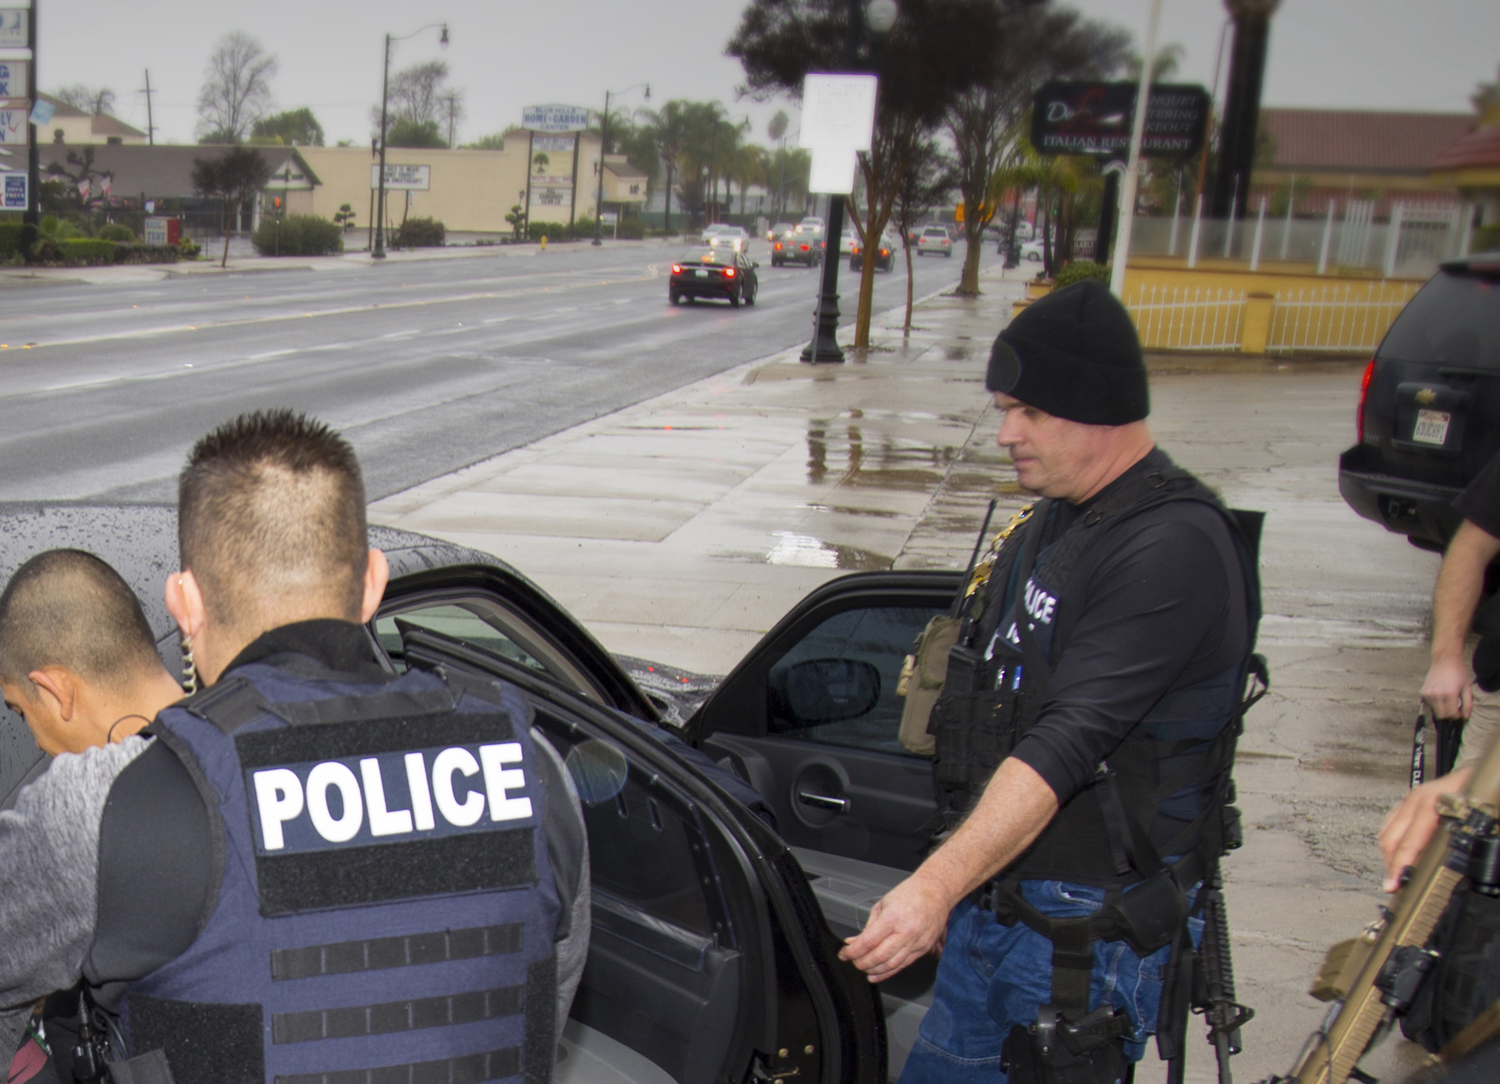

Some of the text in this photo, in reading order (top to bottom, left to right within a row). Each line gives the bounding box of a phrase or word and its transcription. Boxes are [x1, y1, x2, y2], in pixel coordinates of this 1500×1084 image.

[1132, 94, 1196, 107] NQUET
[524, 113, 547, 124] HOME
[553, 114, 587, 124] GARDEN
[1130, 108, 1199, 120] CTERING
[1131, 121, 1192, 133] KEOUT
[1043, 135, 1192, 149] ITALIAN RESTURANT
[253, 742, 533, 851] POLICE
